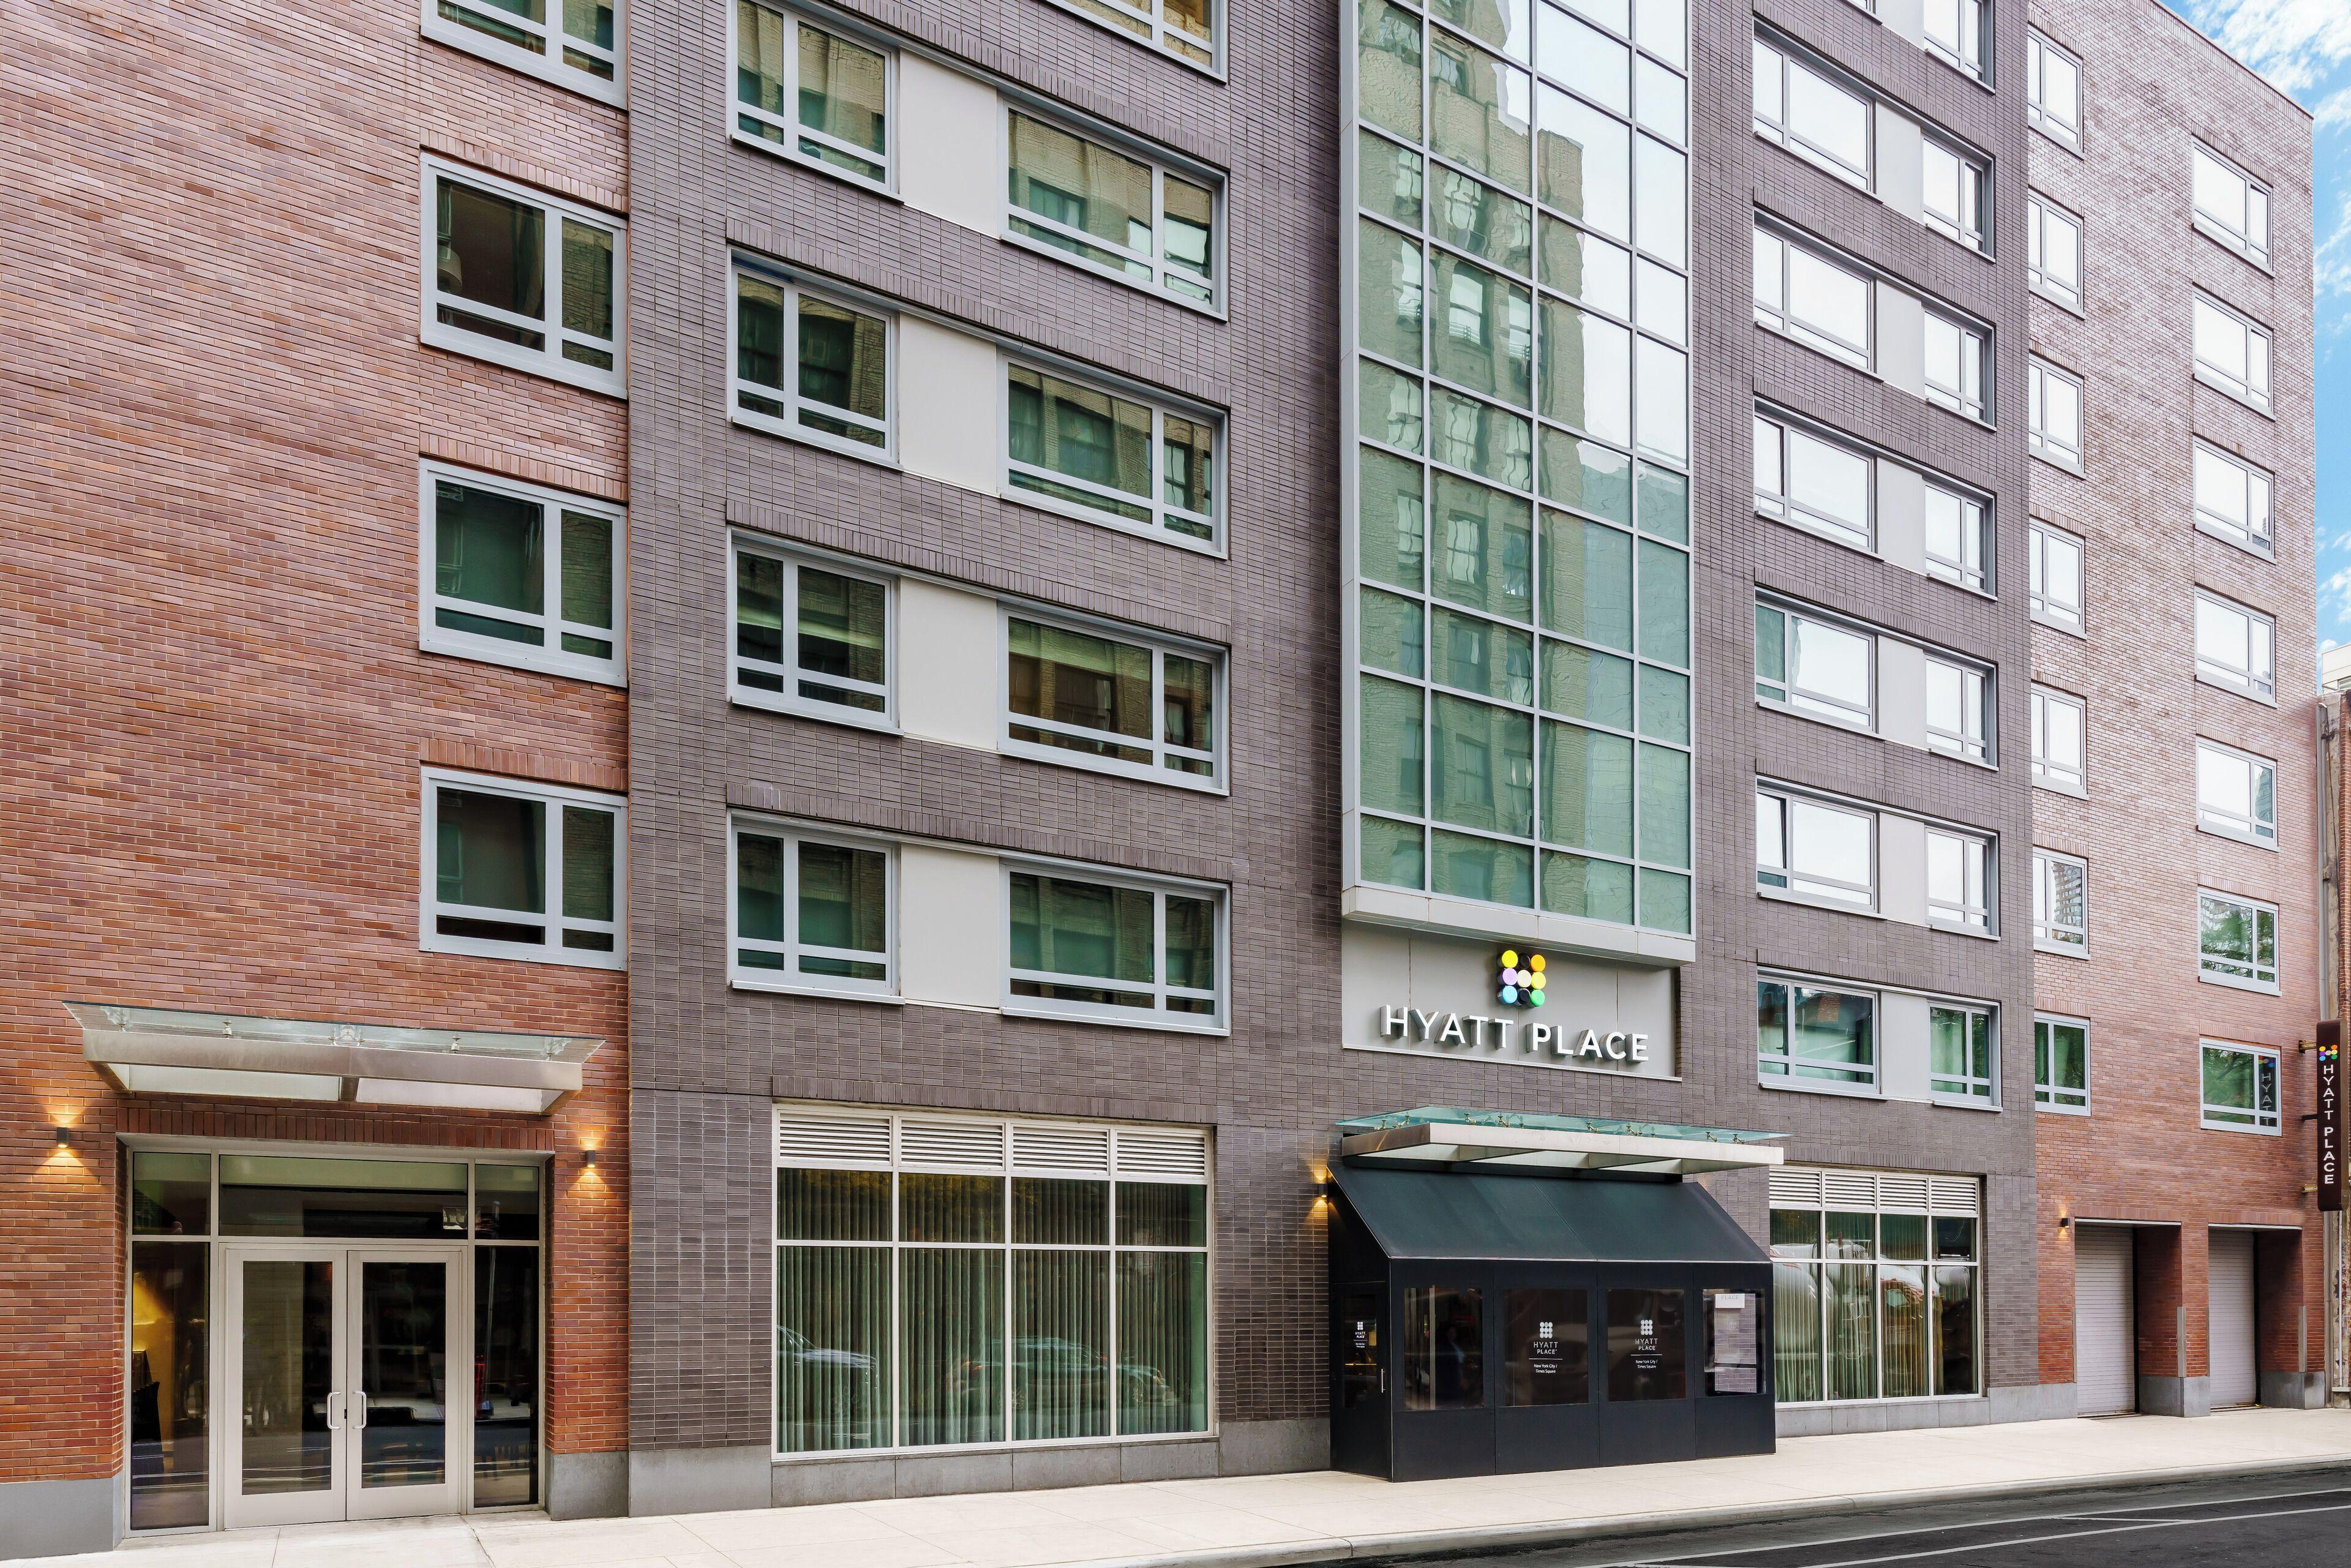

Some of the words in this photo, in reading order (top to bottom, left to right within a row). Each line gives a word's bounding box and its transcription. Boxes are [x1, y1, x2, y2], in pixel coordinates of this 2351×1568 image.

[1379, 1005, 1513, 1049] HYATT
[1526, 1023, 1649, 1062] PLACE
[2323, 1064, 2334, 1120] HYATT
[2323, 1127, 2335, 1184] PLACE
